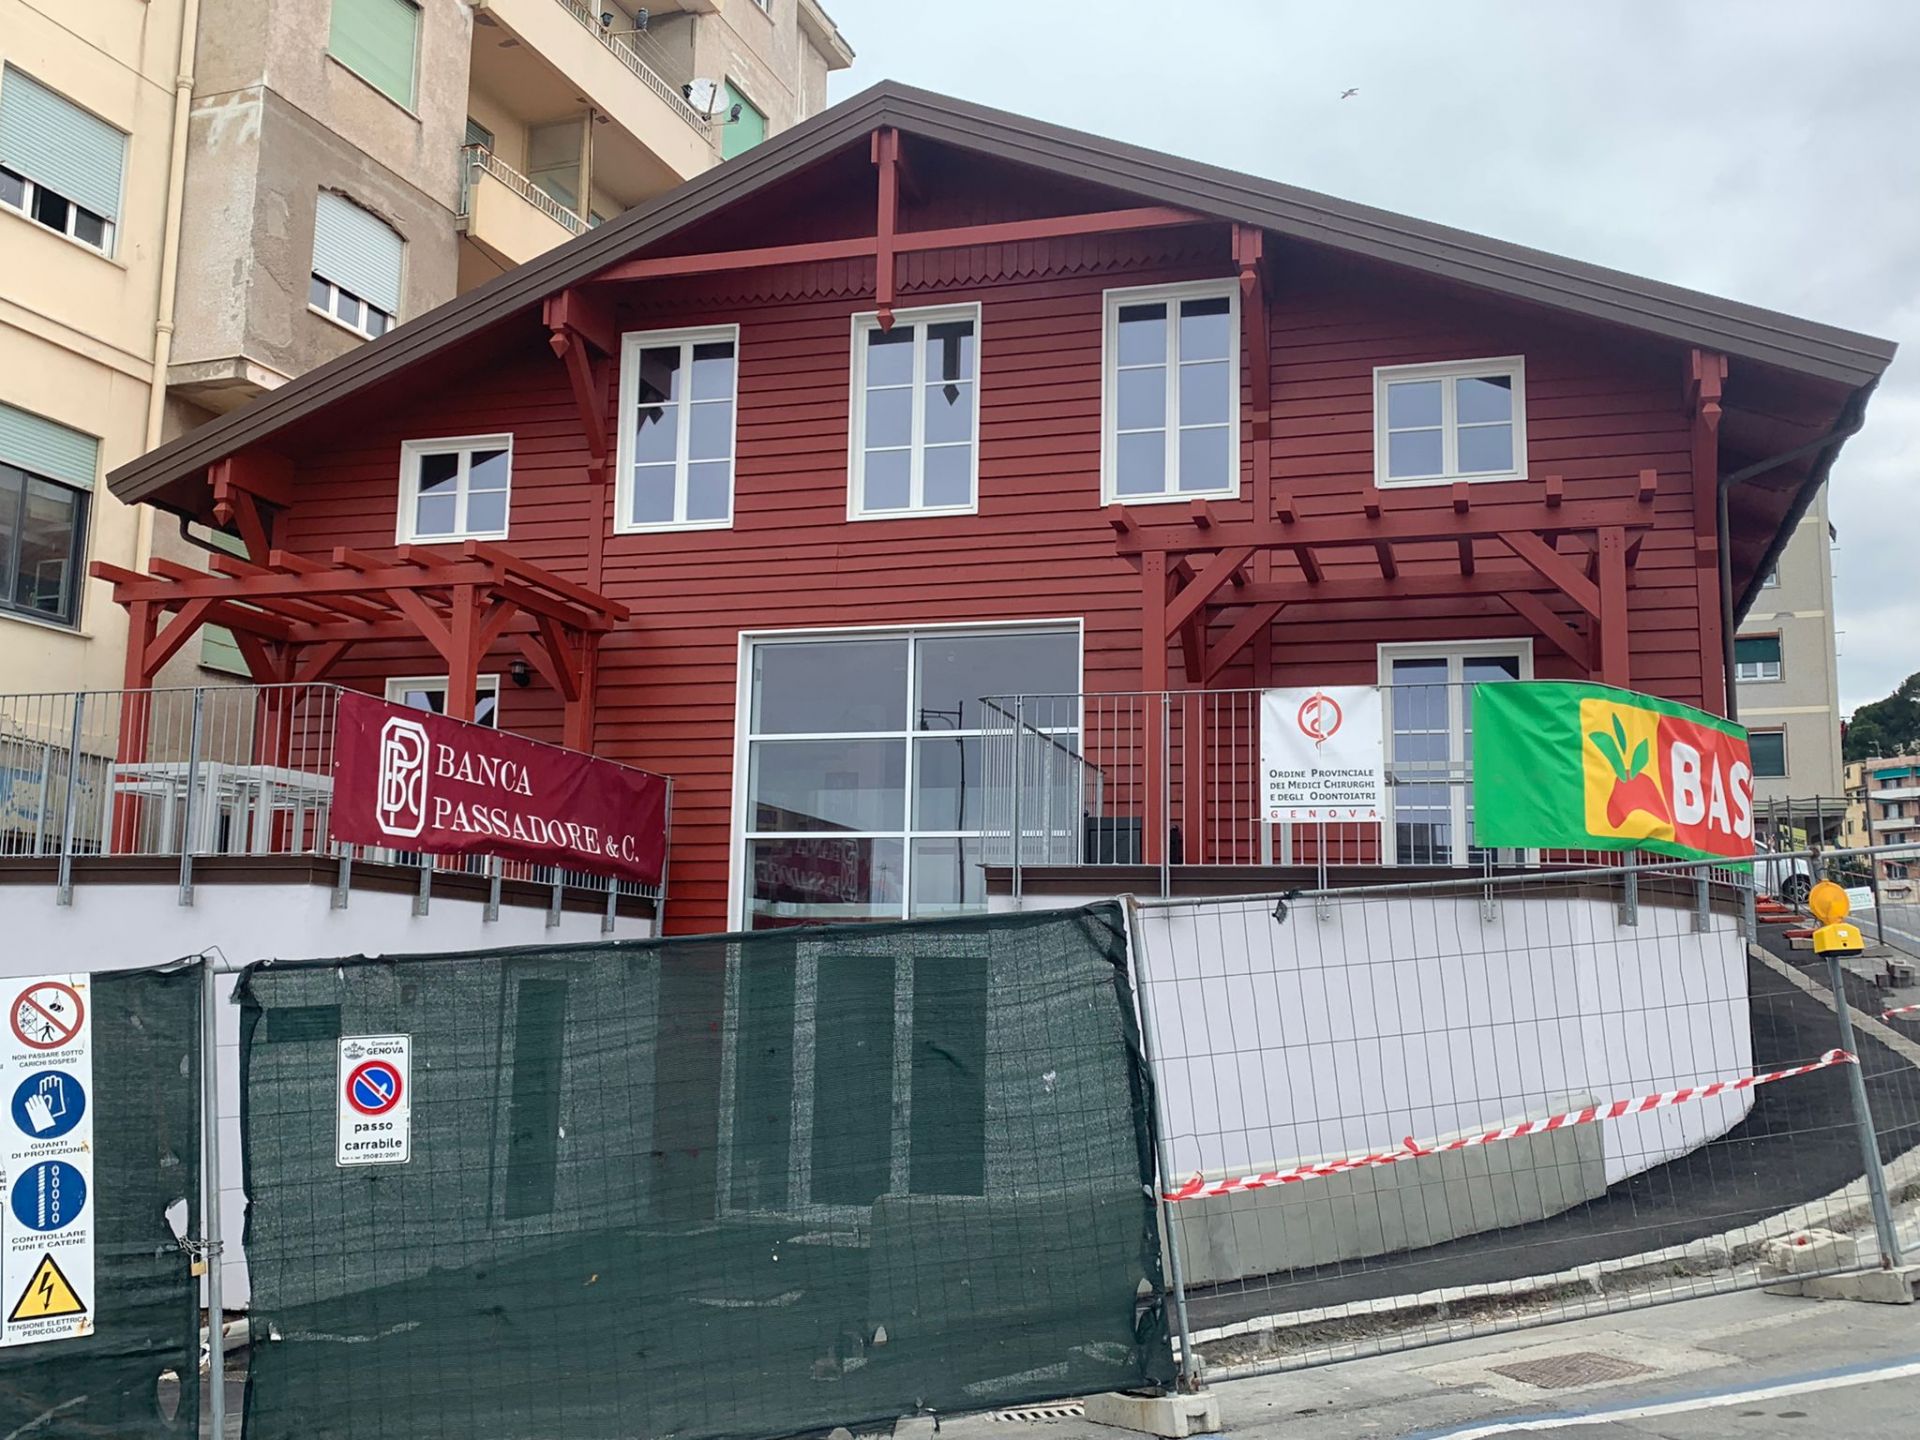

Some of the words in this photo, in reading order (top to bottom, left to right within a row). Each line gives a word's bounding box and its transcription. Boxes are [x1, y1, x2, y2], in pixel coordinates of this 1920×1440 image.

[435, 744, 533, 796] BANCA
[1671, 741, 1755, 842] BAS
[1270, 809, 1377, 818] GENOVA
[432, 797, 601, 854] PASSADORE
[605, 836, 619, 858] &
[622, 835, 640, 862] C.
[29, 1051, 60, 1059] PASSARE
[366, 1046, 404, 1055] GENOVA
[19, 1060, 47, 1068] CARICHI
[48, 1057, 77, 1065] SOSPESI
[354, 1122, 393, 1134] passo
[30, 1140, 68, 1149] GUANTI
[345, 1137, 402, 1151] carrabile
[24, 1146, 87, 1158] PROTEZIONE
[12, 1230, 87, 1244] CONTROLLARE
[12, 1243, 35, 1252] FUNI
[47, 1238, 86, 1248] CATENE
[8, 1321, 45, 1332] TENSIONE
[47, 1316, 87, 1326] ELETTRICA
[22, 1325, 72, 1337] PERICOLOSA
